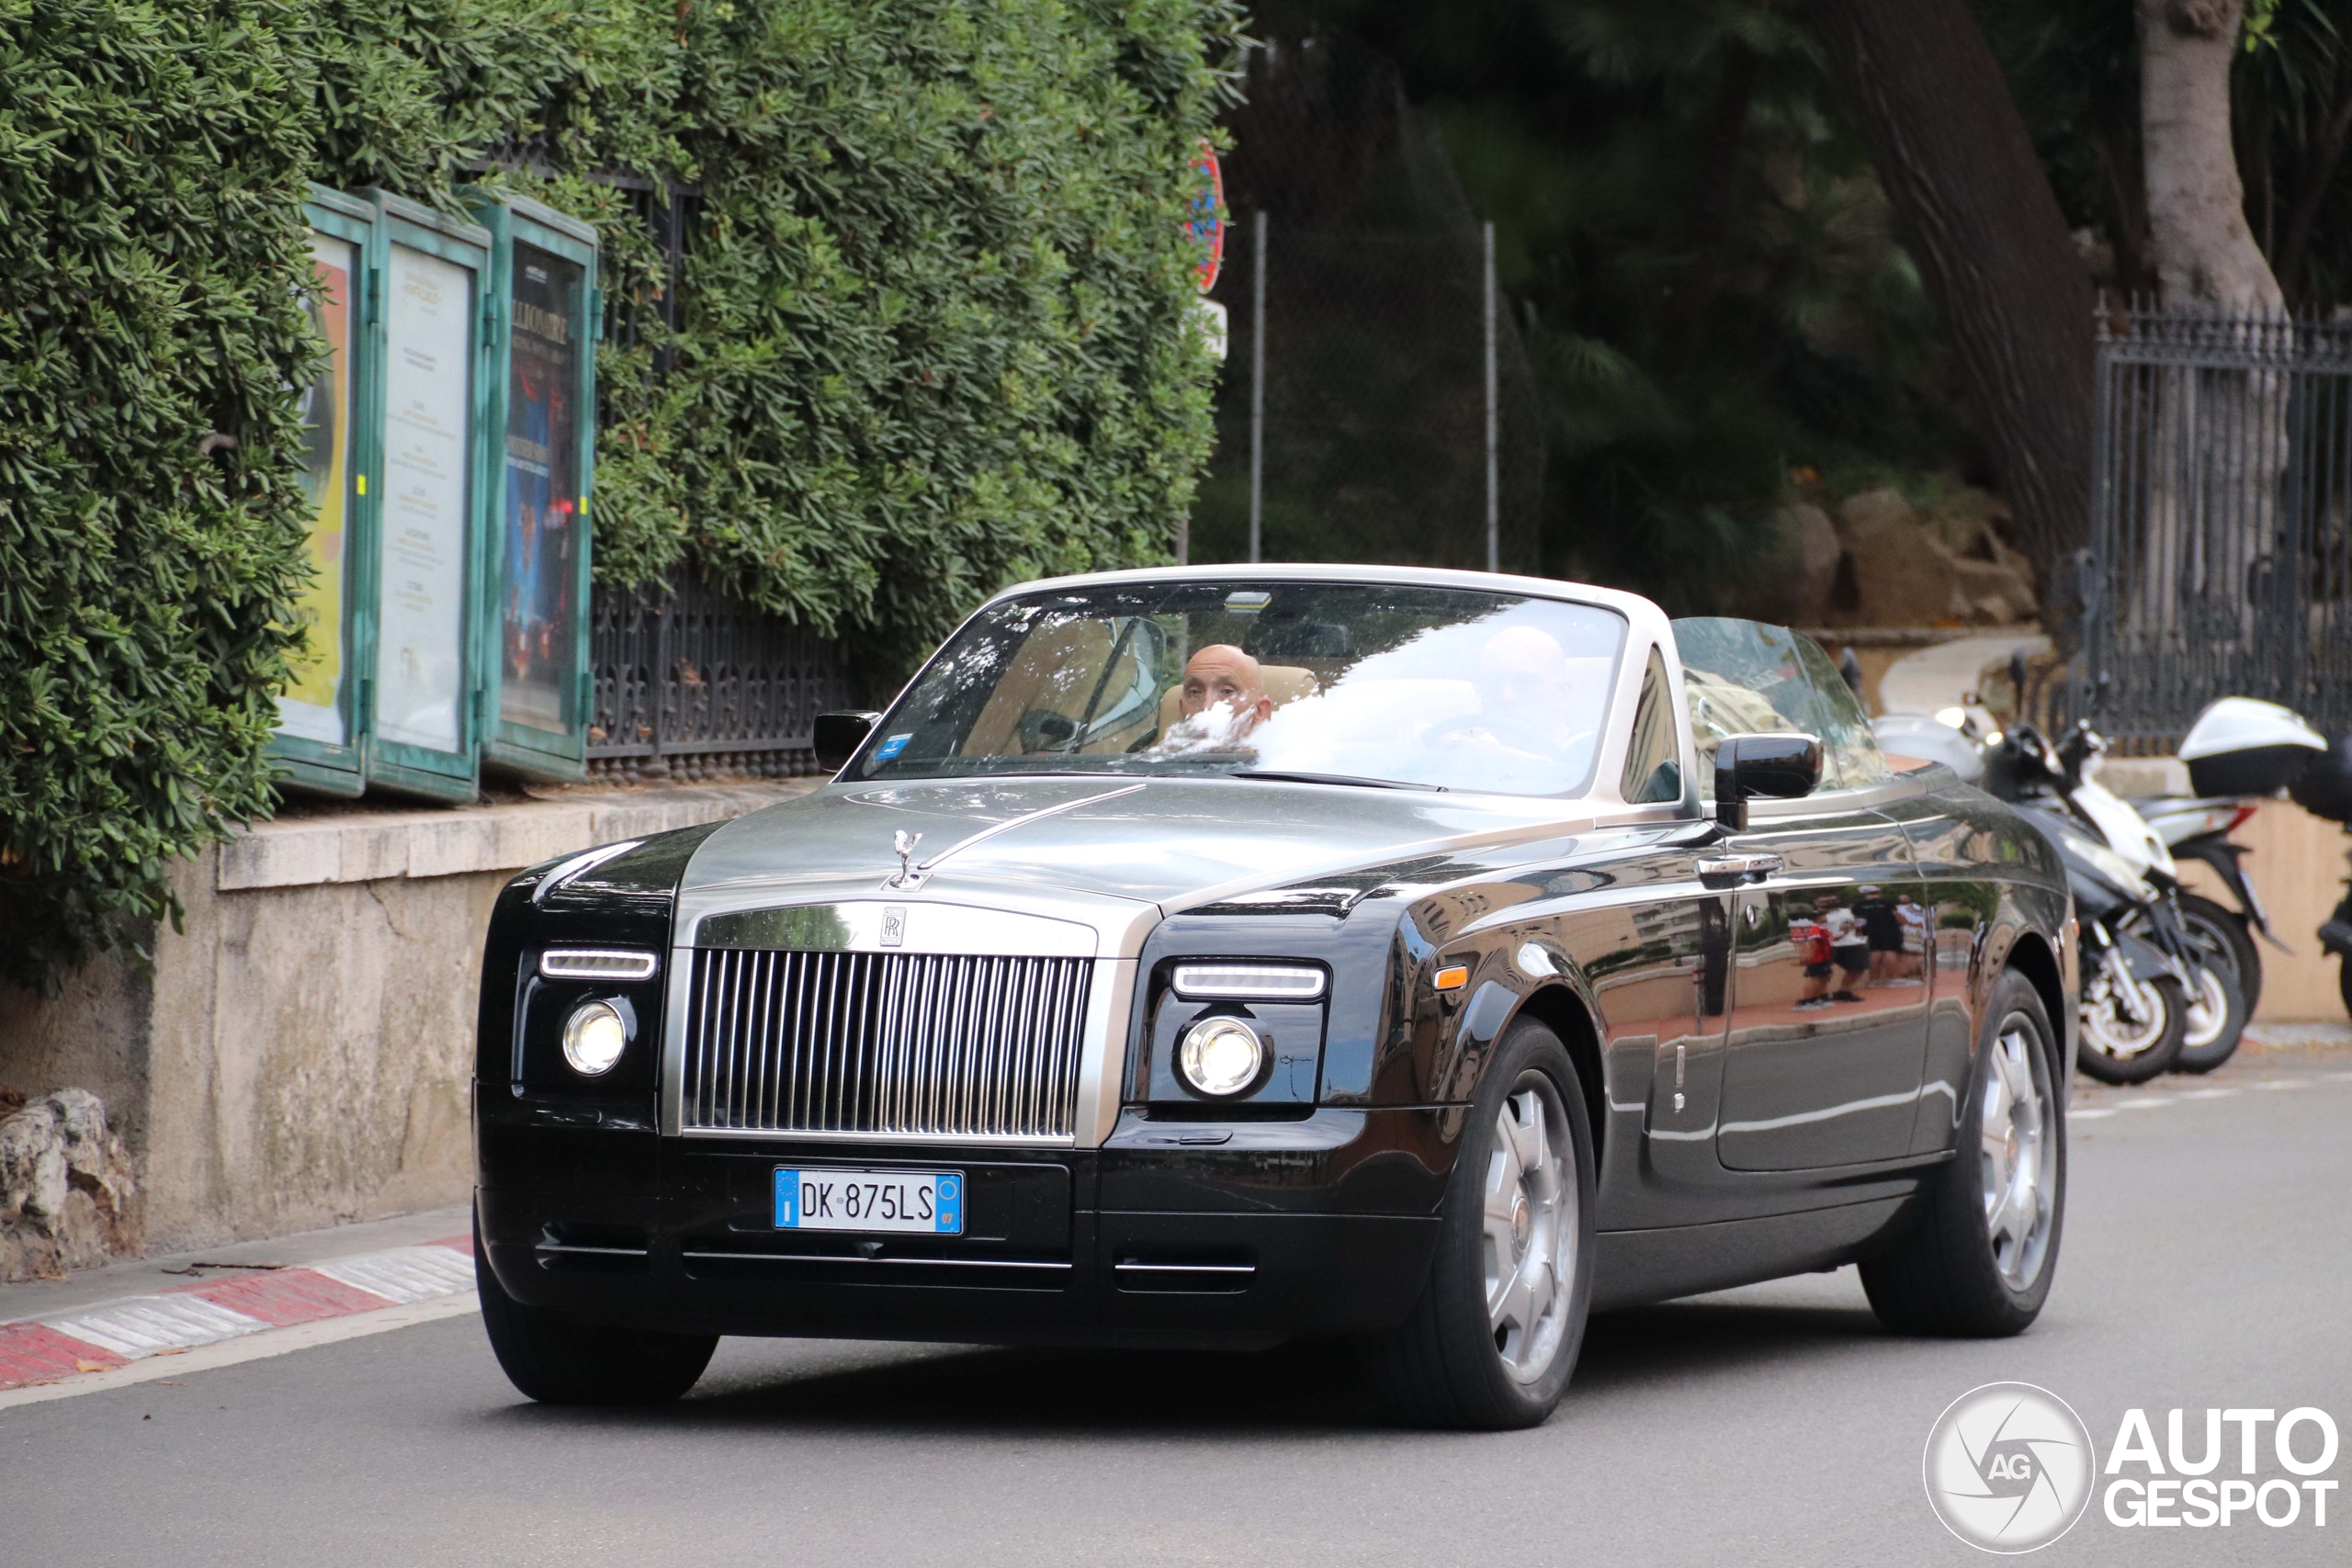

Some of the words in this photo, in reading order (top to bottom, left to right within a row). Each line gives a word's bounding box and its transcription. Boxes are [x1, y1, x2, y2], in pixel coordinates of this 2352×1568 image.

[802, 1183, 833, 1217] DK
[845, 1183, 933, 1220] 875LS
[942, 1213, 953, 1224] 07
